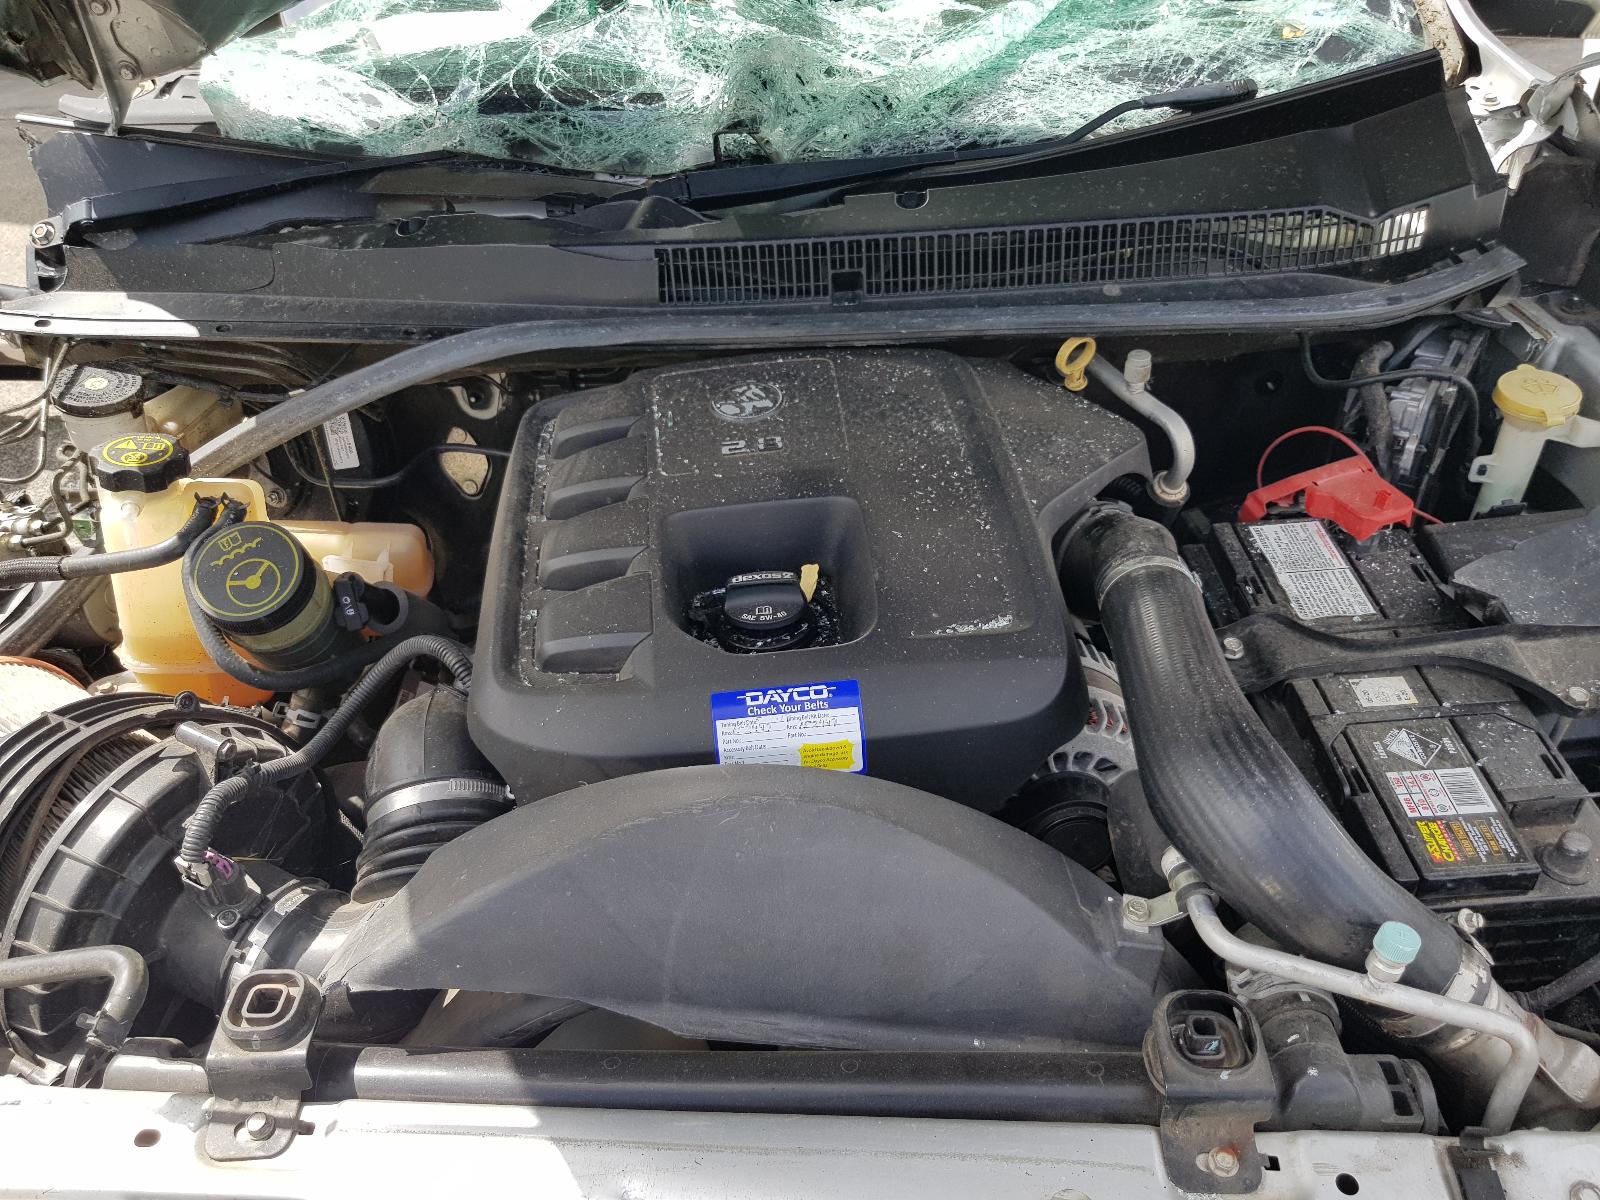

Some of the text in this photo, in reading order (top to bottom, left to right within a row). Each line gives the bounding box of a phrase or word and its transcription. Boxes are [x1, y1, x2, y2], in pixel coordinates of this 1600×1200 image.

[720, 437, 783, 455] 2.8
[732, 571, 795, 584] dexos2
[741, 613, 757, 621] SAE
[745, 685, 829, 706] DAYCO
[747, 700, 829, 717] Check Your Belts
[1409, 734, 1427, 760] CORROSIVE
[1415, 820, 1441, 857] SUPER
[1428, 820, 1455, 862] CHARGE
